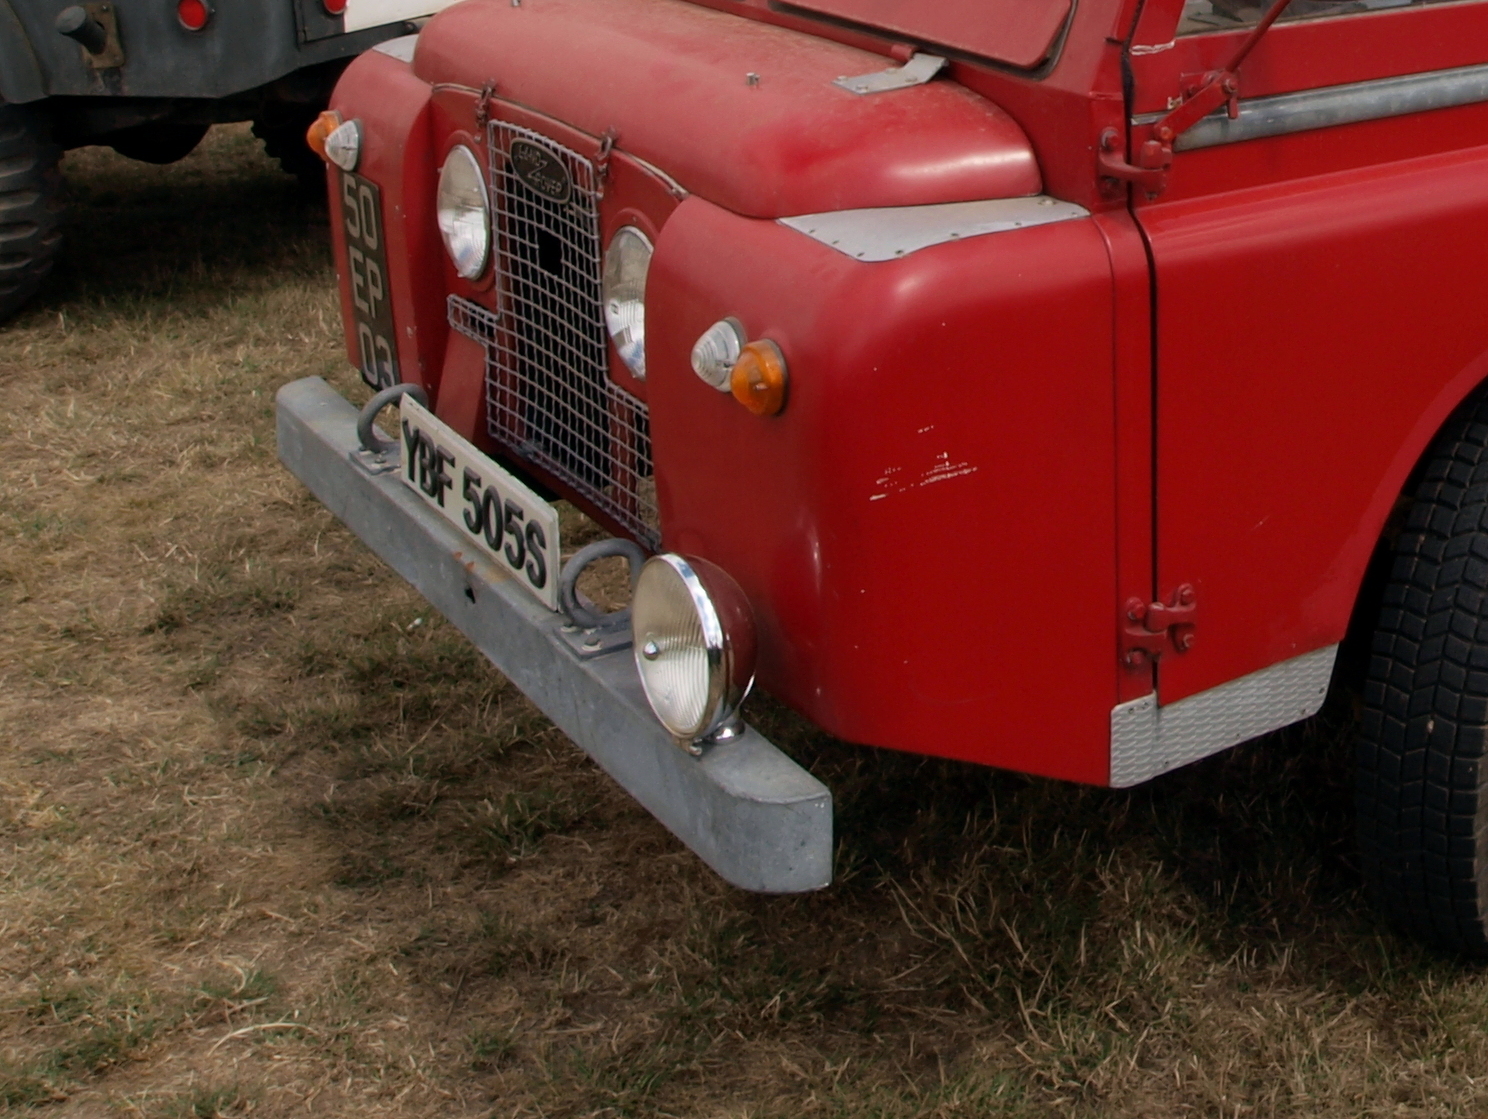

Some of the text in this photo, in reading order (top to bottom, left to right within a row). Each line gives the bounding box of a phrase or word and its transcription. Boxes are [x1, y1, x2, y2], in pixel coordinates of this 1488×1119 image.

[344, 172, 378, 251] 50
[349, 245, 383, 319] EP
[402, 416, 548, 590] YBF 505S
